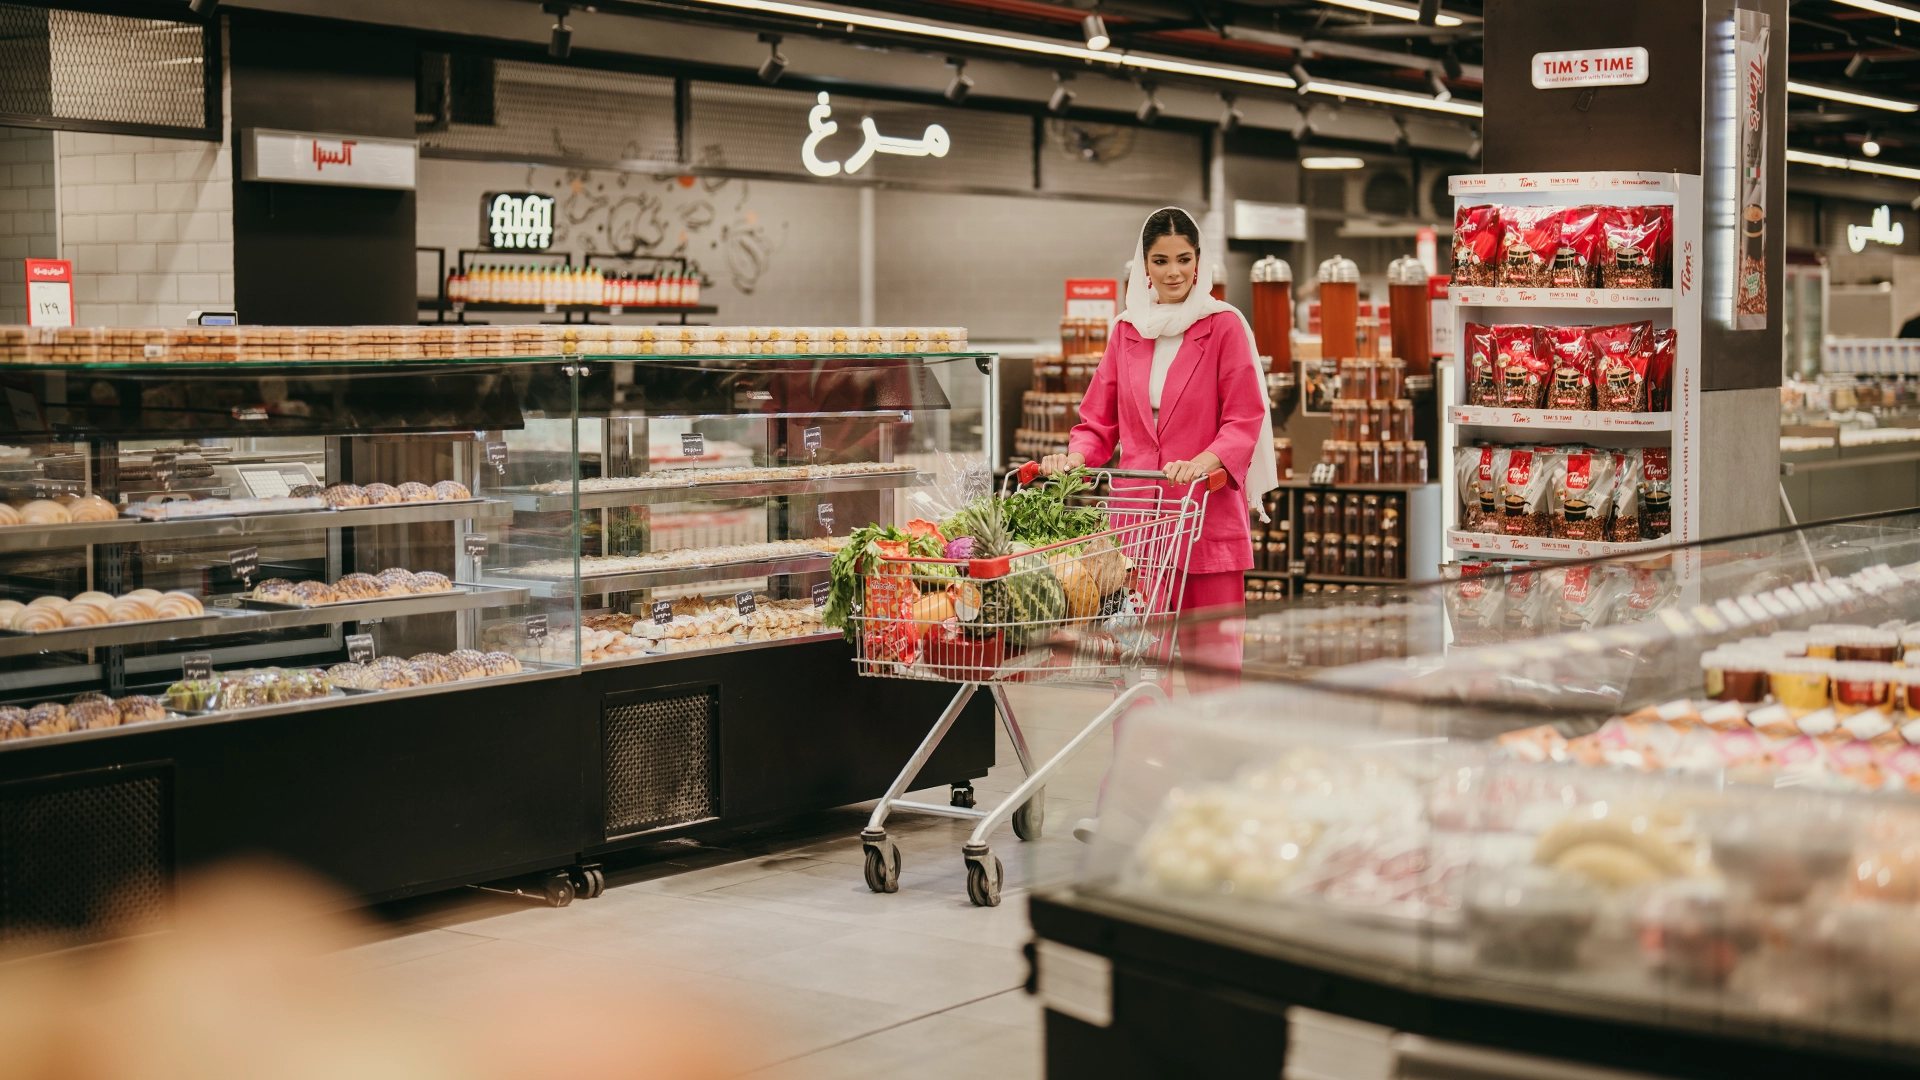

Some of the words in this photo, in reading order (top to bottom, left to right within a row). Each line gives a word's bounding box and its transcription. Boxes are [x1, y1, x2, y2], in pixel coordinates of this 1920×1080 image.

[1544, 60, 1589, 75] TIM'S
[1595, 57, 1633, 72] TIME
[1750, 54, 1763, 131] Tim's
[802, 91, 950, 177] مرغ
[1519, 177, 1537, 188] Tim's
[493, 232, 550, 249] SAUCE
[1680, 240, 1692, 297] Tim's
[1518, 291, 1537, 301] Tim's
[1511, 340, 1531, 351] Tim's
[1609, 341, 1630, 352] Tim's
[1512, 412, 1531, 423] Tim's
[1508, 467, 1529, 480] Tim's
[1645, 464, 1668, 475] Tim's
[1568, 471, 1588, 484] Tim's
[1510, 539, 1529, 550] Tim's
[1461, 582, 1480, 593] Tim's
